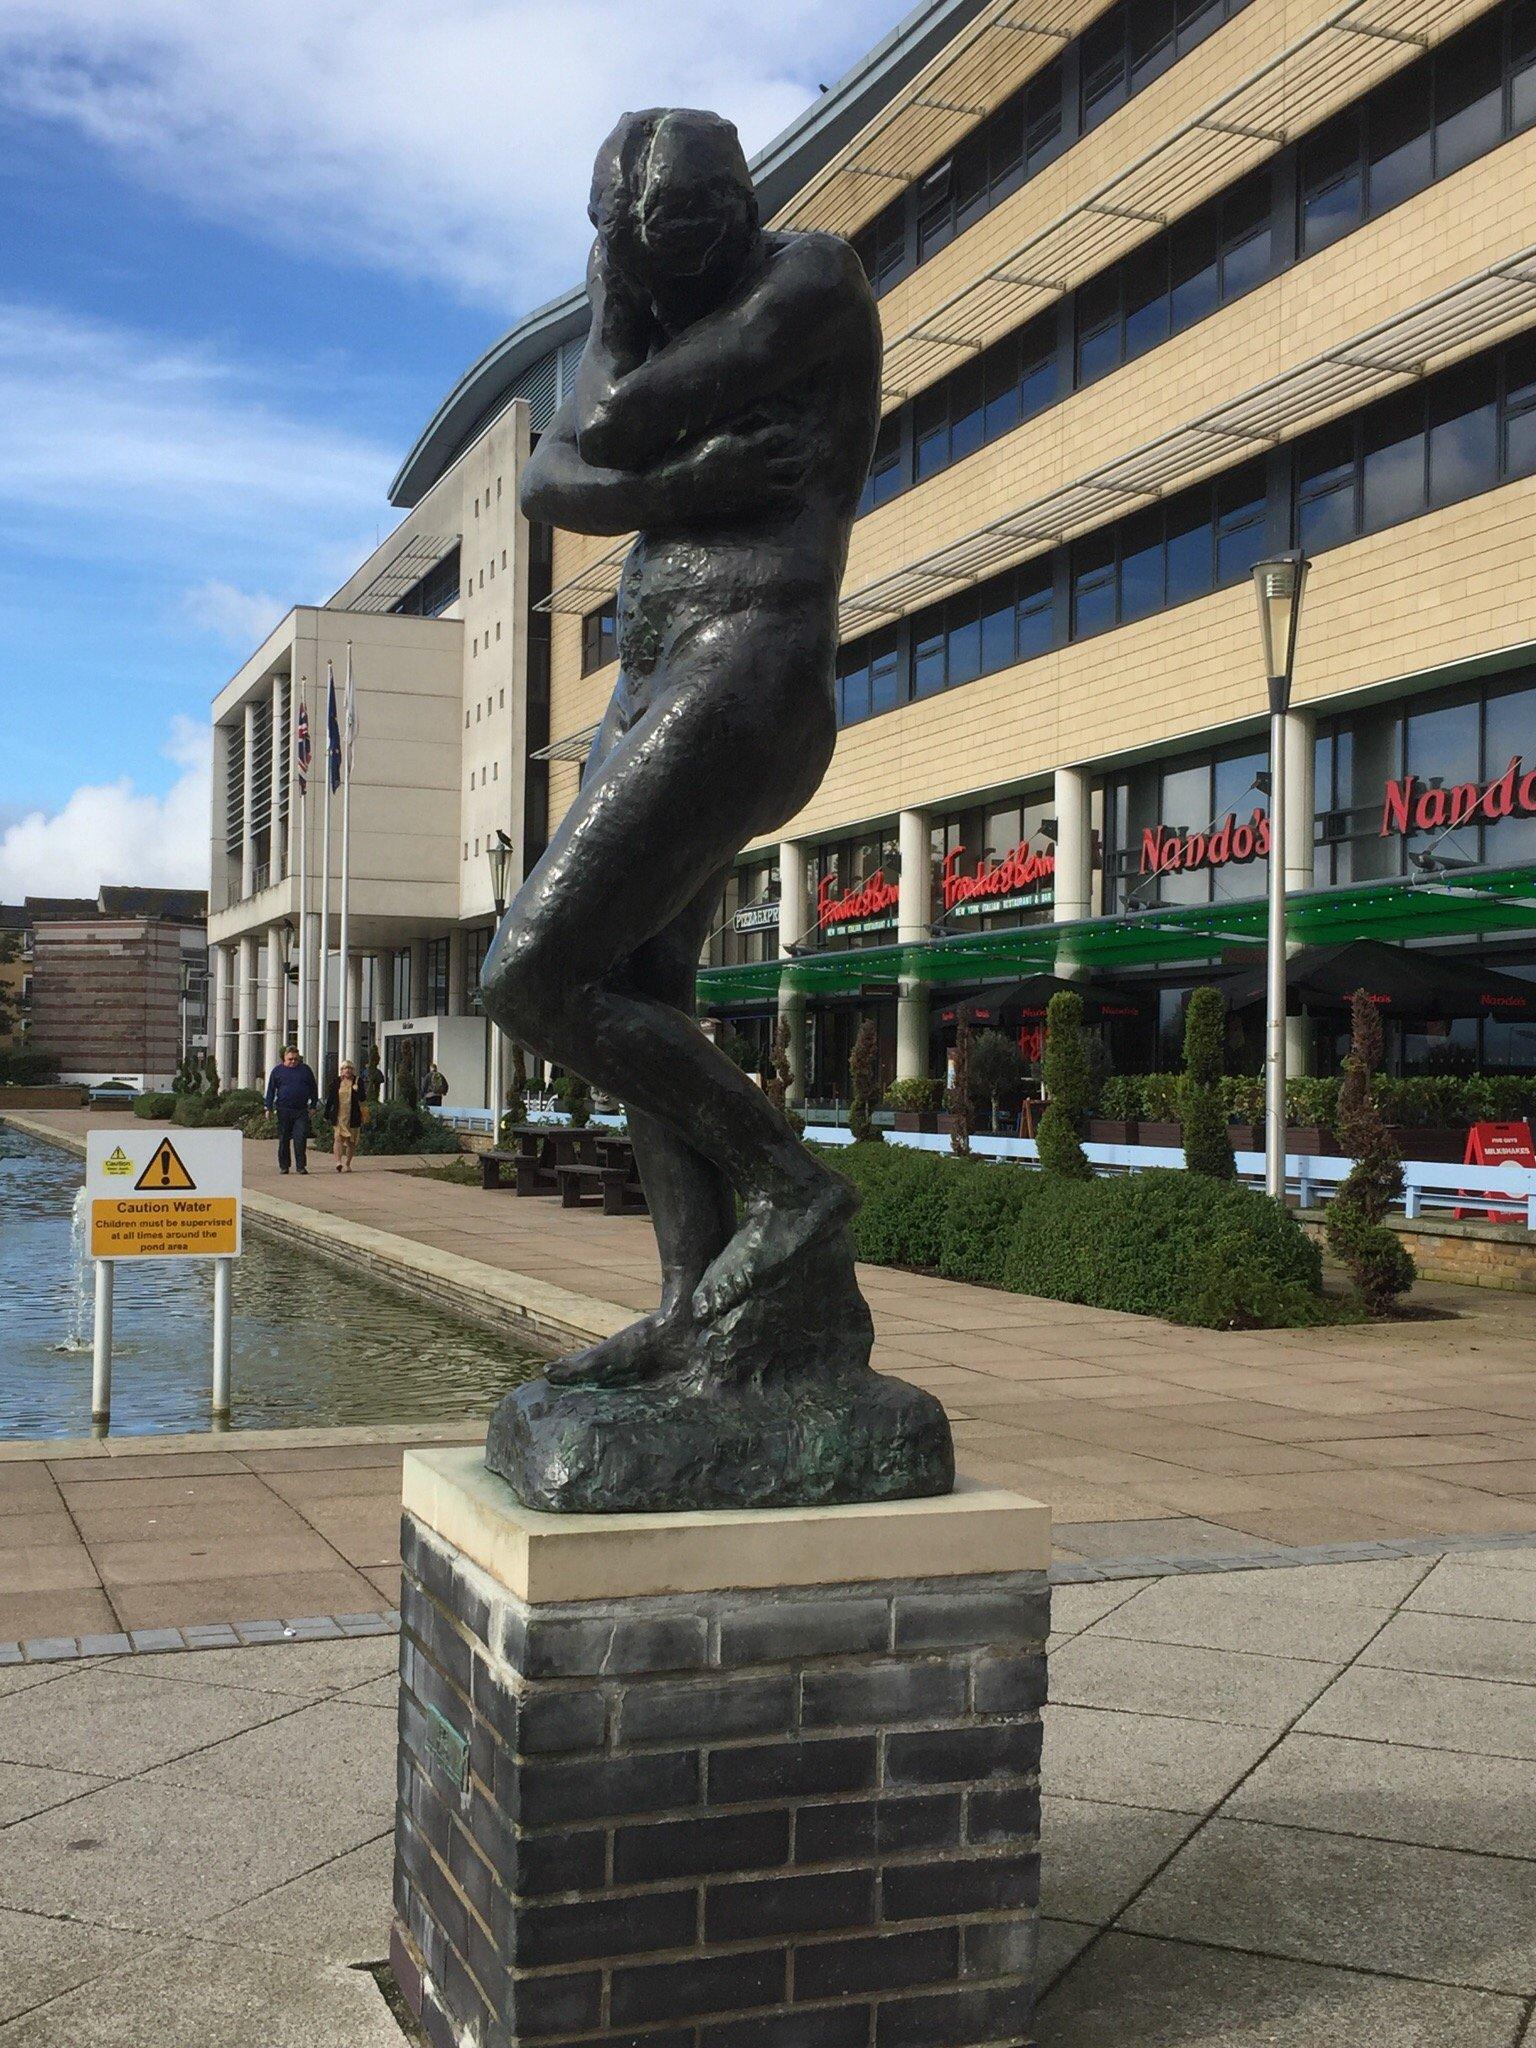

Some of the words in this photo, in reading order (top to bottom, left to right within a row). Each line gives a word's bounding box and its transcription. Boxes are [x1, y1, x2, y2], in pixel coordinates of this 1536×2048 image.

[1139, 807, 1270, 876] Nando's
[736, 907, 780, 928] PIZZAEXPR
[117, 1202, 169, 1213] Caution
[174, 1202, 212, 1213] Water
[95, 1219, 137, 1228] Children
[140, 1219, 164, 1228] must
[166, 1218, 178, 1227] be
[181, 1218, 233, 1228] supervised
[111, 1232, 121, 1240] at
[123, 1231, 135, 1240] all
[137, 1231, 163, 1239] times
[166, 1230, 199, 1239] around
[202, 1230, 217, 1238] the
[140, 1243, 165, 1252] pond
